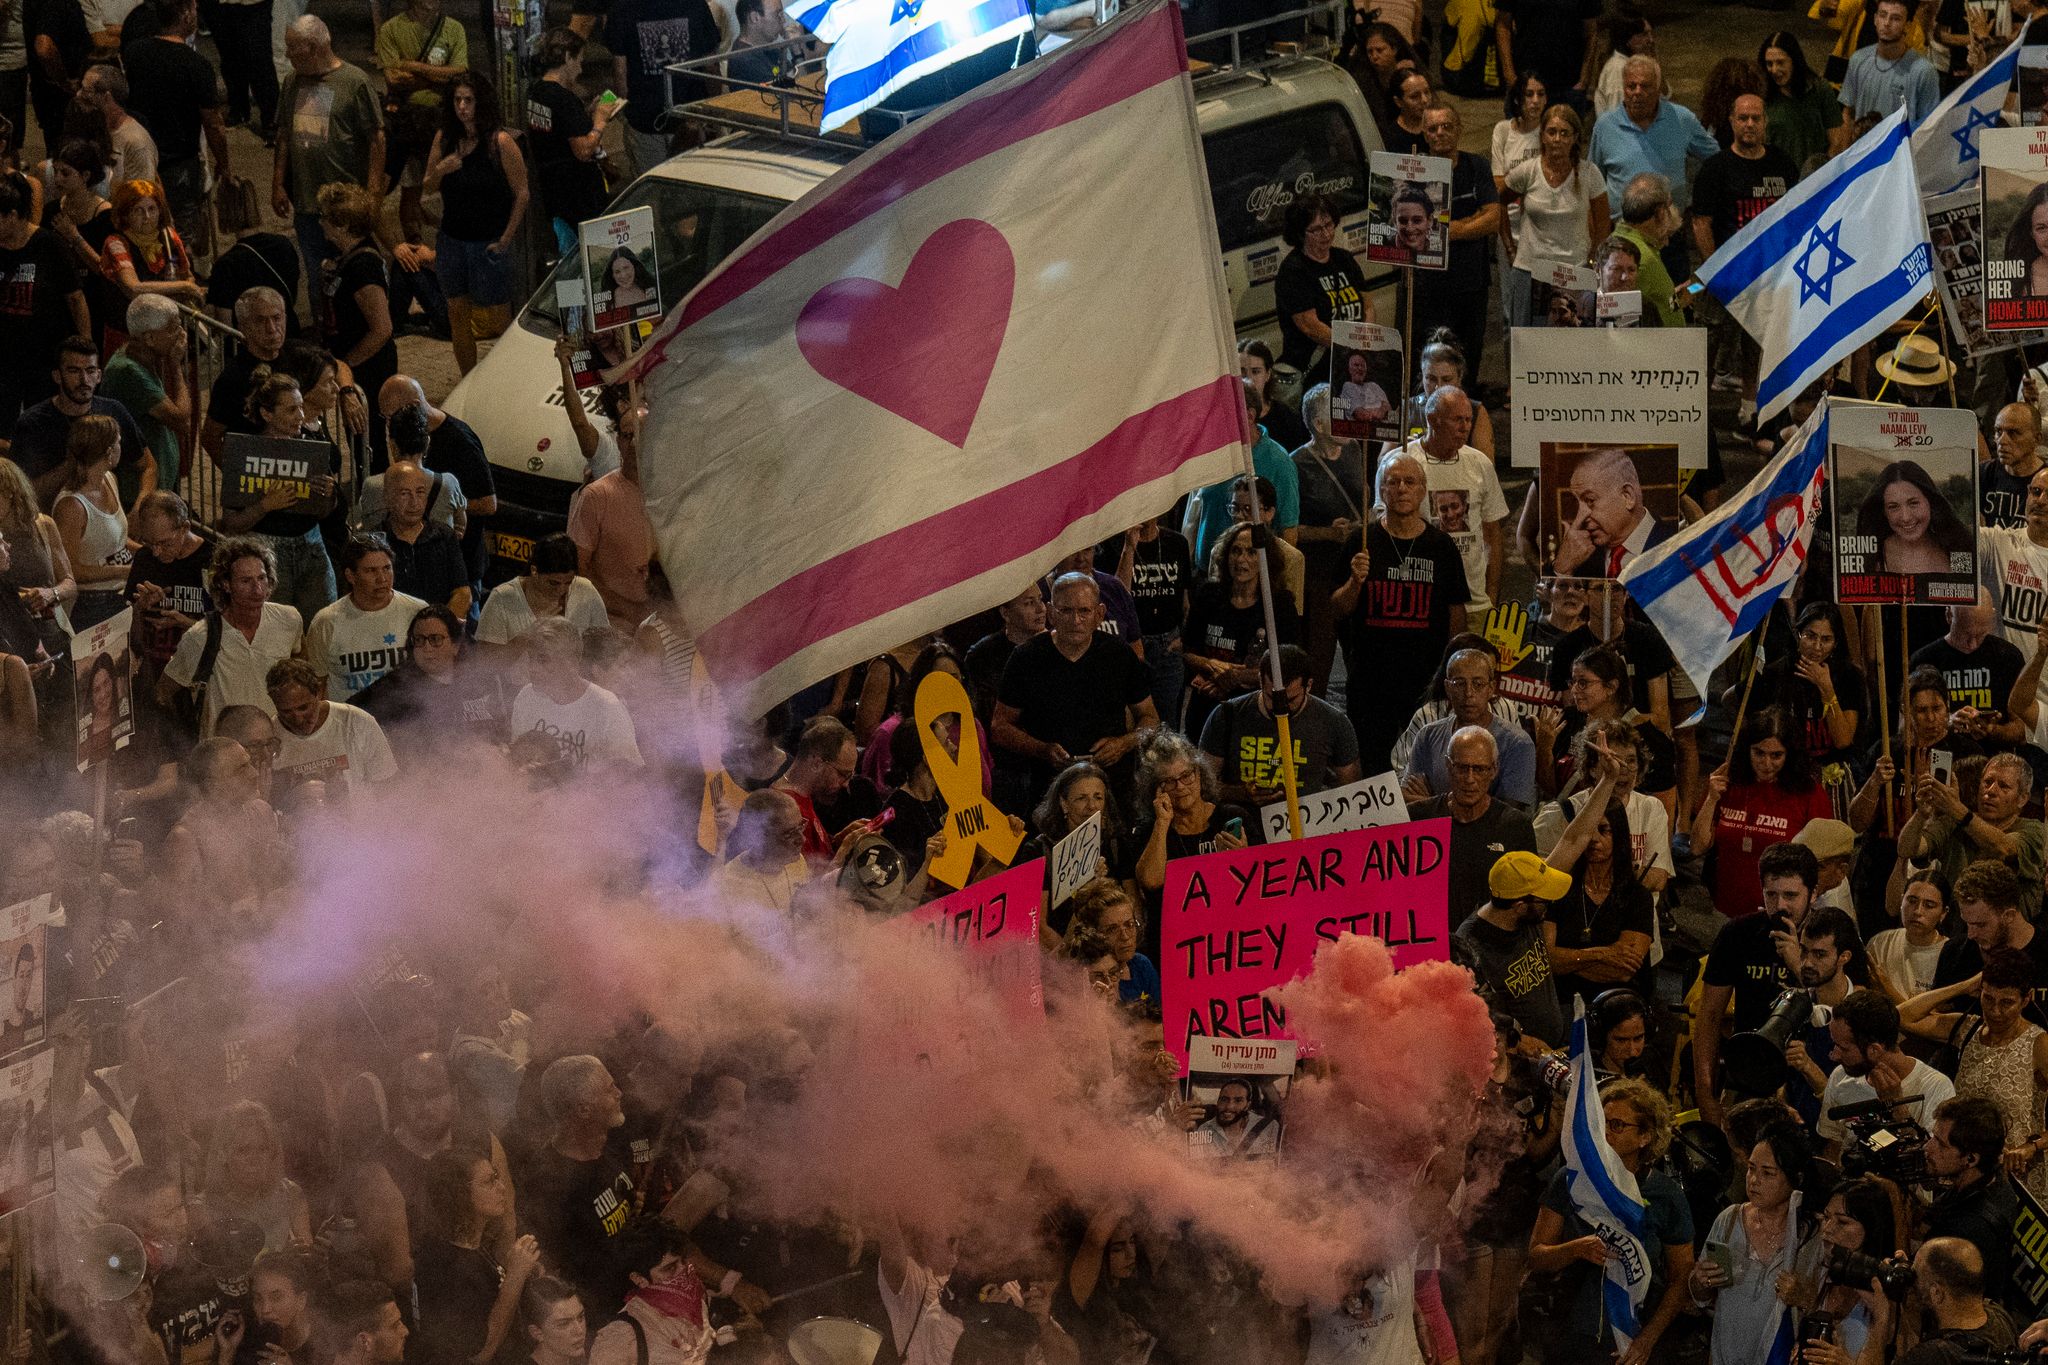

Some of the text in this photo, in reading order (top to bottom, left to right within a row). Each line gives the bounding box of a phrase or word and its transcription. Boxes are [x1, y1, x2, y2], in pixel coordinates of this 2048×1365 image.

[616, 232, 630, 245] 20
[1900, 245, 1926, 271] ופשי
[1988, 260, 2025, 280] BRING
[594, 290, 612, 304] BRING
[1988, 281, 2012, 300] HER
[594, 302, 607, 313] HER
[1988, 302, 2024, 321] HOME
[573, 361, 588, 374] HER
[1598, 372, 1623, 385] את
[1532, 408, 1605, 422] החטופים
[1611, 408, 1635, 422] את
[1640, 405, 1701, 426] להפקיר
[1888, 412, 1919, 423] נעמה לוי
[1880, 424, 1927, 434] NAAMA LEVY
[1915, 436, 1933, 446] 20
[246, 456, 308, 478] עסקה
[240, 475, 310, 499] עיו!
[1984, 490, 2028, 518] STIL
[1840, 536, 1877, 554] BRING
[1840, 555, 1864, 573] HER
[2008, 560, 2029, 575] BRING
[1841, 575, 1915, 595] HOME NOW!
[2006, 571, 2042, 590] THEM HOME
[1366, 580, 1432, 618] עכשיו
[1929, 589, 1974, 599] FAMILIES FORUM
[1964, 667, 1991, 688] למה
[1949, 689, 1992, 708] עדיי
[954, 804, 989, 839] NOW.
[1720, 806, 1788, 829] מאבק הנשי
[1182, 835, 1443, 912] A YEAR AND
[1176, 923, 1287, 980] THEY
[1505, 961, 1550, 998] WAR
[1212, 1044, 1277, 1061] מתן עדיין חי
[1189, 1130, 1213, 1146] BRING
